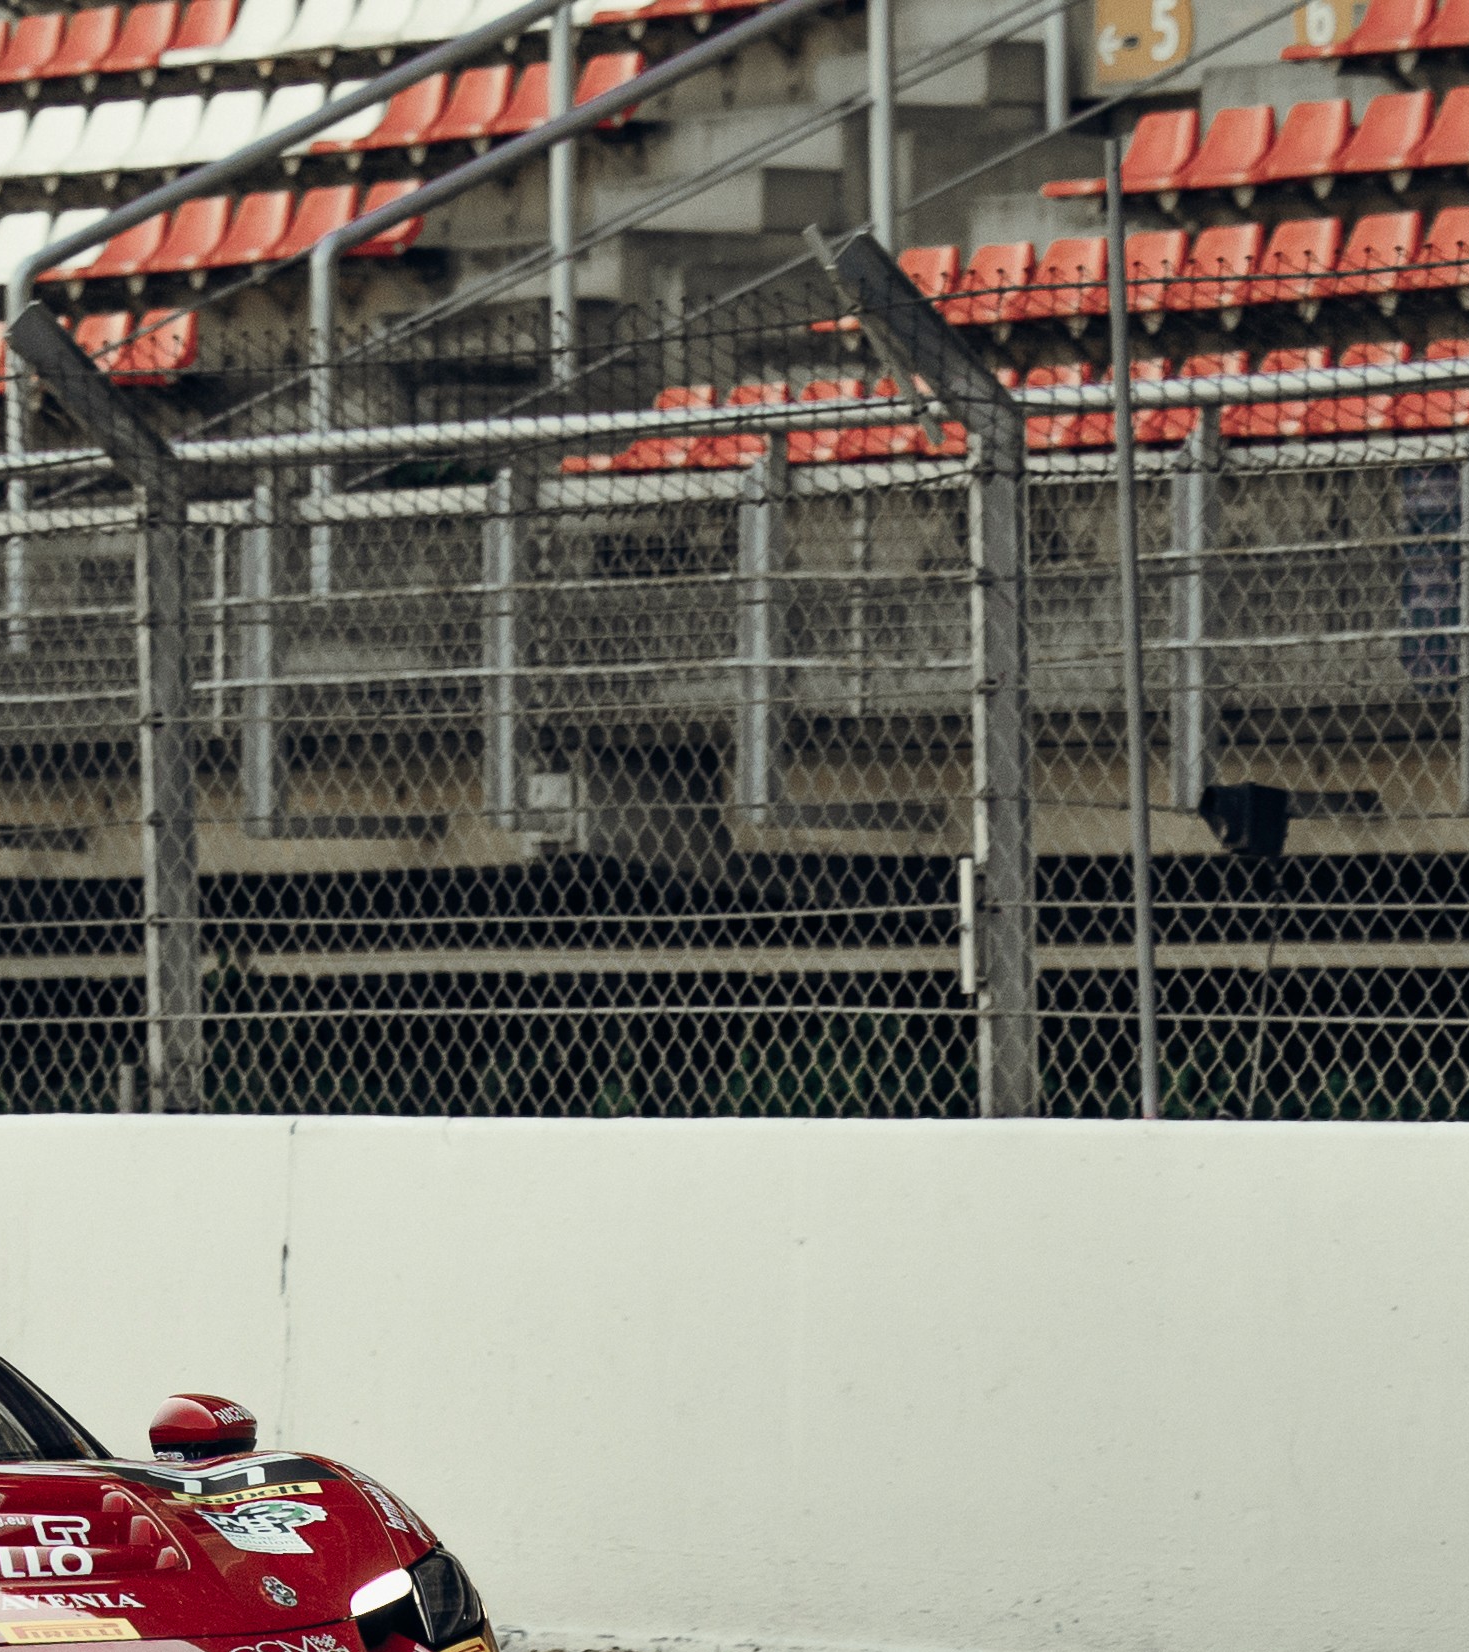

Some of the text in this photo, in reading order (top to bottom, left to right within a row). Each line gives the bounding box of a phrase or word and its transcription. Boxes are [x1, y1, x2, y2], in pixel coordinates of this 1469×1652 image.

[1151, 0, 1180, 61] 5
[32, 1515, 91, 1546] GR
[11, 1623, 124, 1640] PIRELLI
